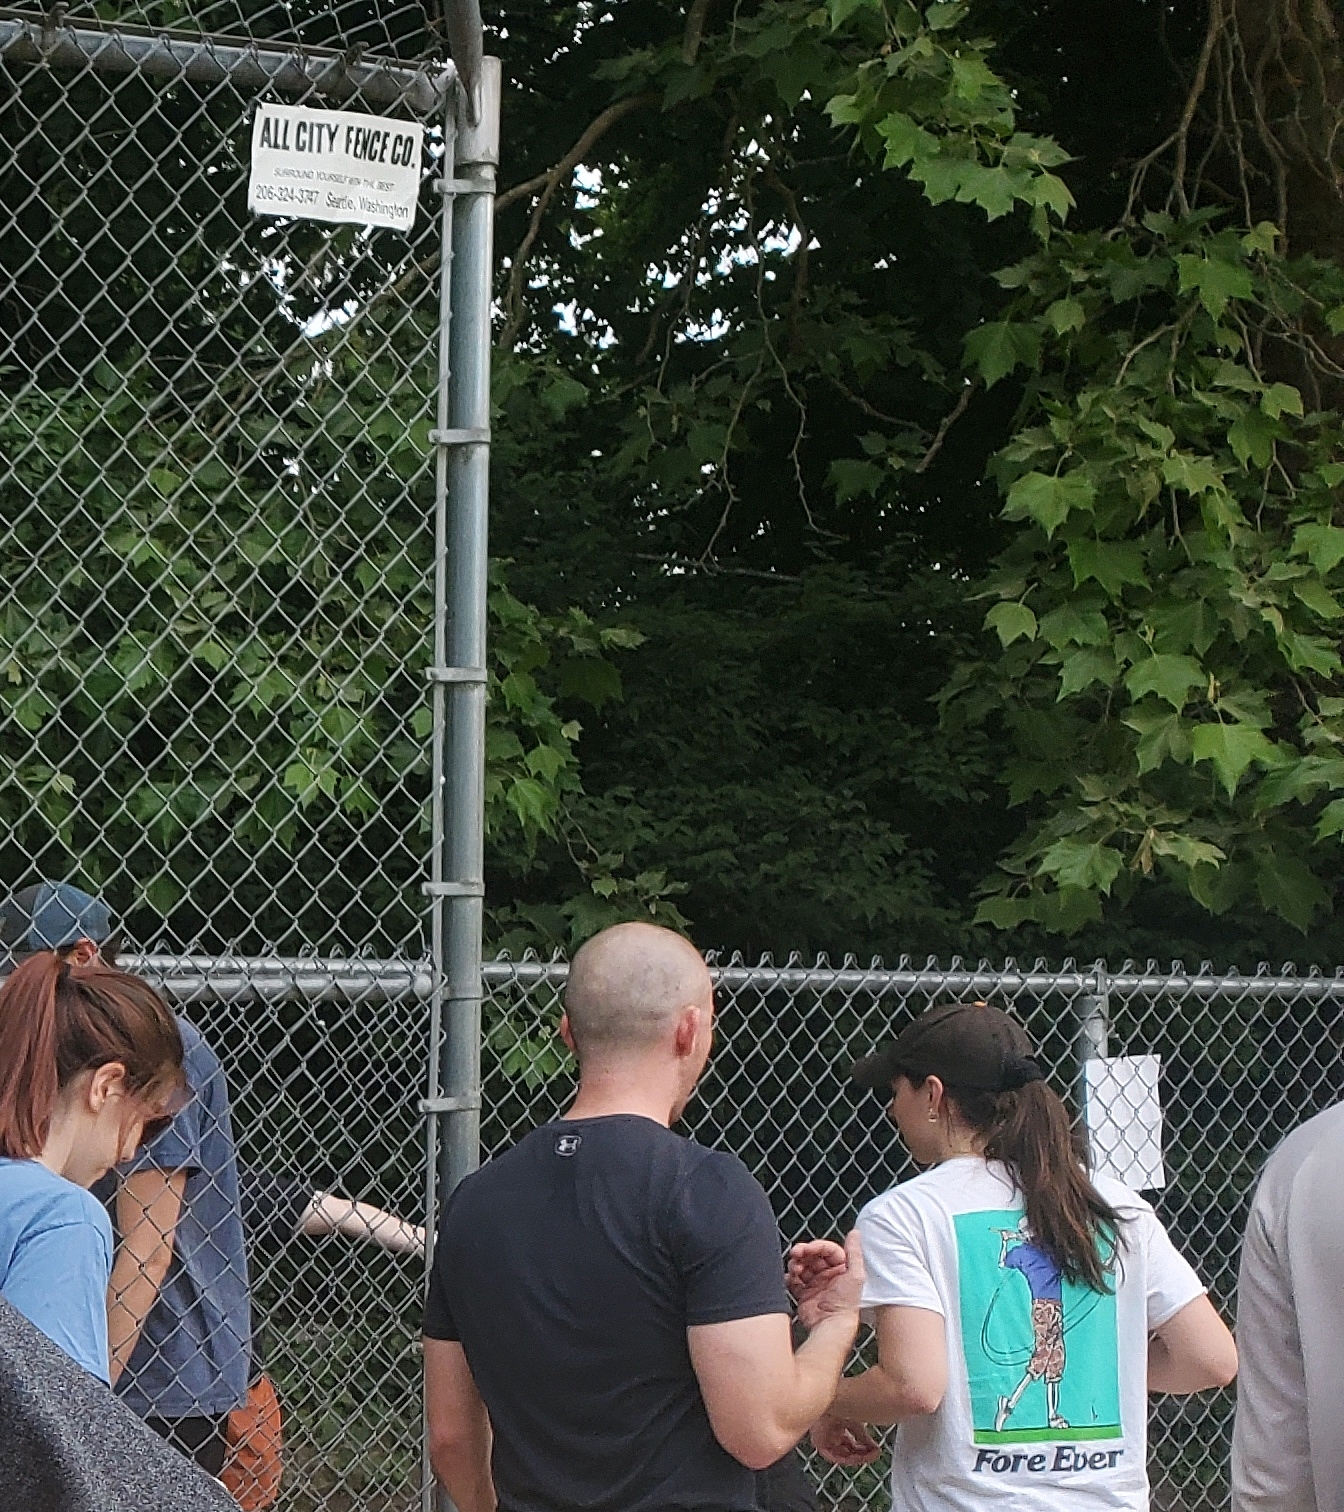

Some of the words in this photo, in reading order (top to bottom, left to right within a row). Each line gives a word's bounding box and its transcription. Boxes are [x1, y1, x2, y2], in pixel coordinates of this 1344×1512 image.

[260, 117, 290, 150] ALL
[295, 121, 339, 154] CITY
[345, 125, 390, 163] FENCE
[391, 134, 415, 168] CO.
[359, 195, 409, 219] Washington
[972, 1448, 1046, 1473] Fore
[1050, 1446, 1124, 1472] Ever
